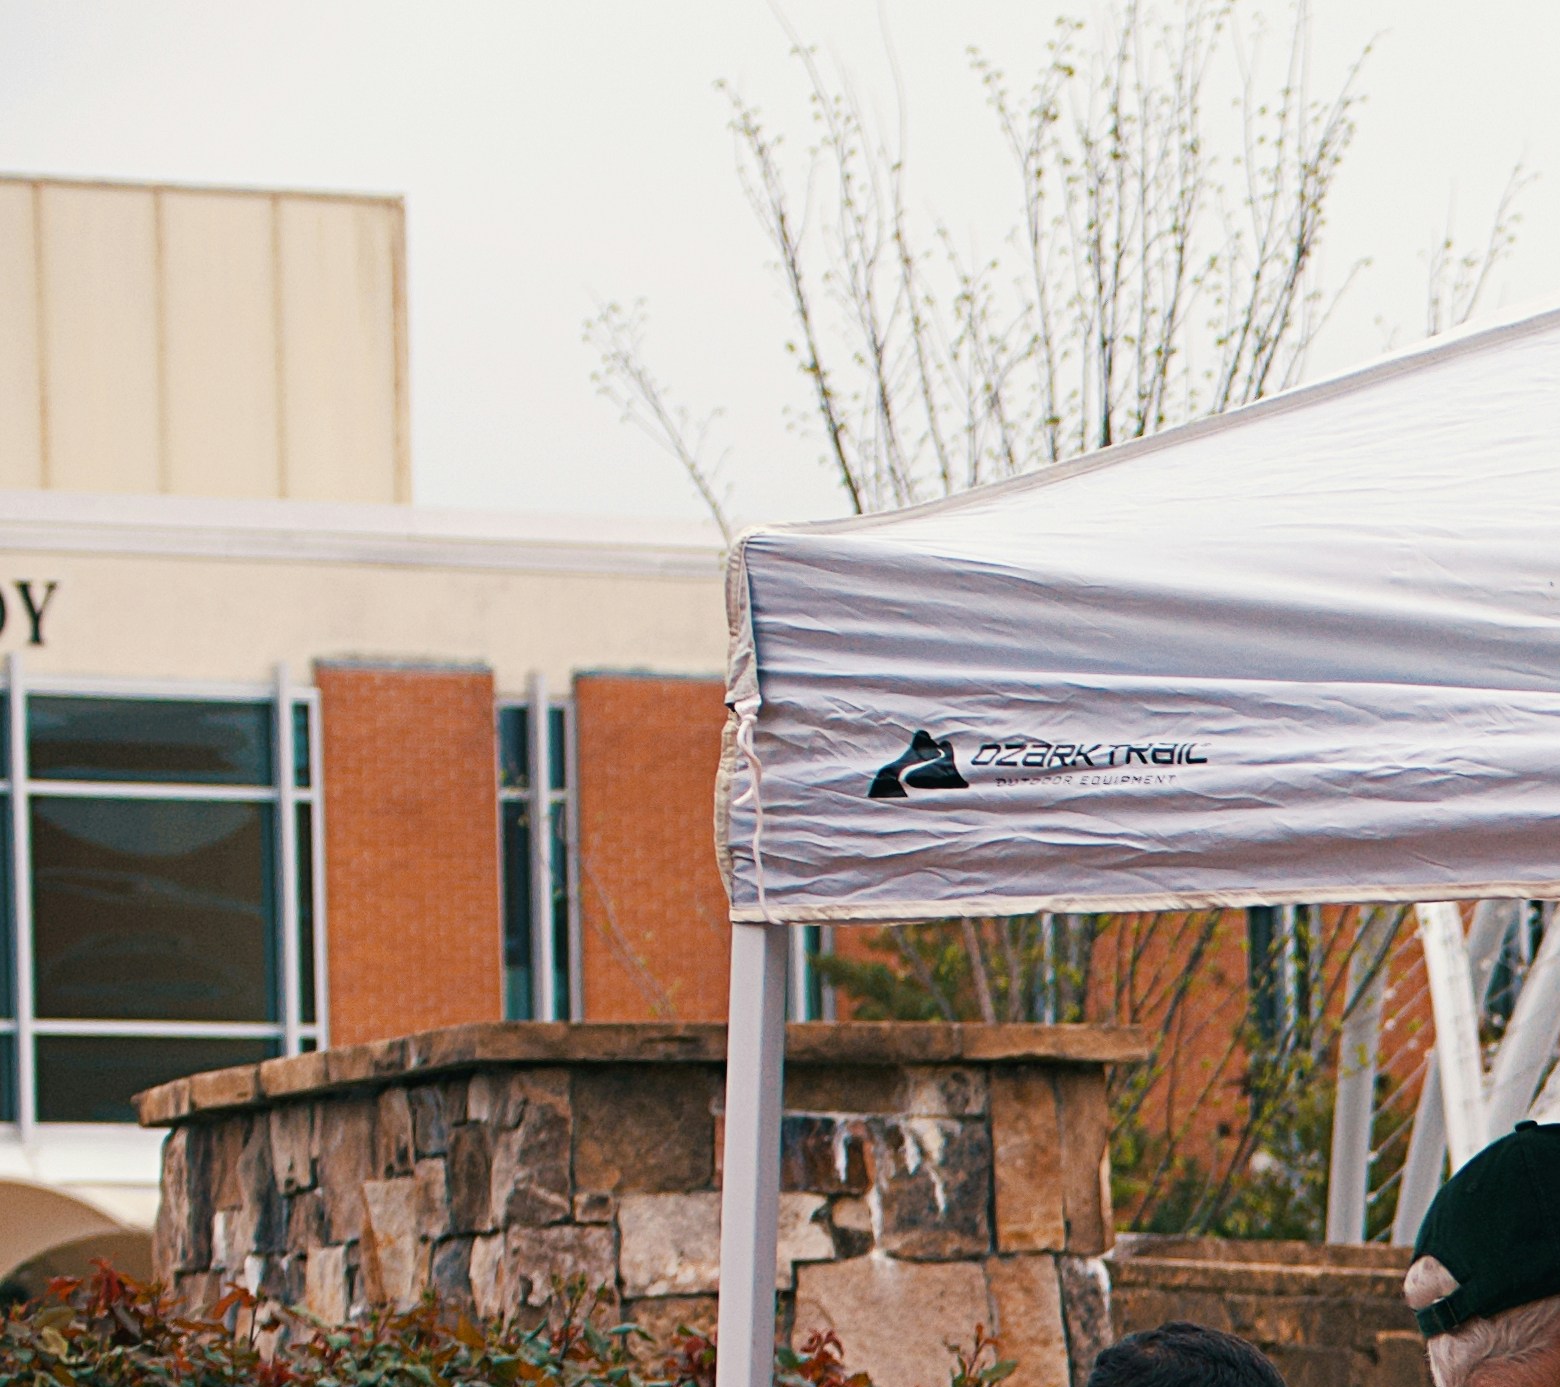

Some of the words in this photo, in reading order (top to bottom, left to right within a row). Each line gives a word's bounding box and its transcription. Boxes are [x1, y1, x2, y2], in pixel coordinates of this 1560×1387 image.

[0, 580, 59, 647] Y
[971, 743, 1101, 767] OZARK
[1106, 743, 1213, 765] TRAIL
[1079, 775, 1177, 786] EQUIPMENT
